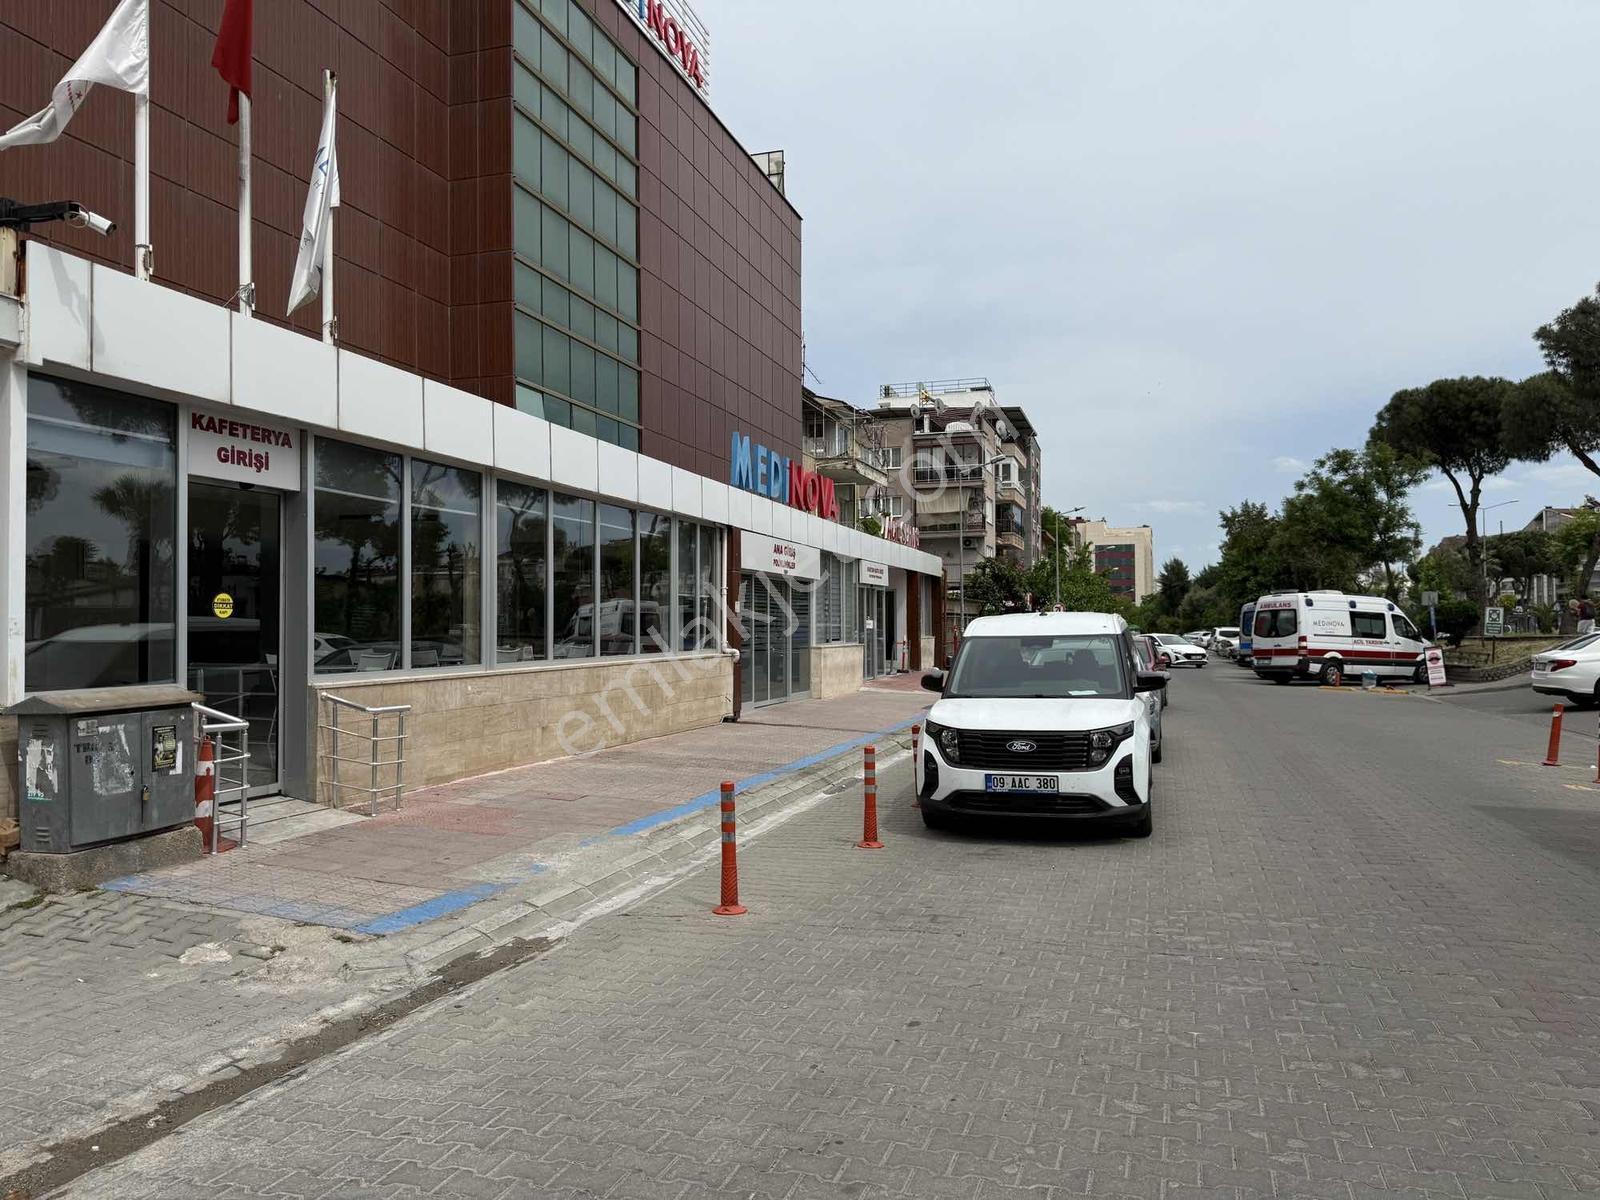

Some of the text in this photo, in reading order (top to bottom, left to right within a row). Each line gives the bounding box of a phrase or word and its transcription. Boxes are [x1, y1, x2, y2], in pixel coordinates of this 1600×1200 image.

[192, 412, 292, 449] KAFETERYA
[217, 445, 269, 473] GİRİŞİ
[1260, 601, 1291, 609] AMBULANS
[1011, 742, 1031, 751] Ford
[992, 776, 1056, 790] 09 AAC 380
